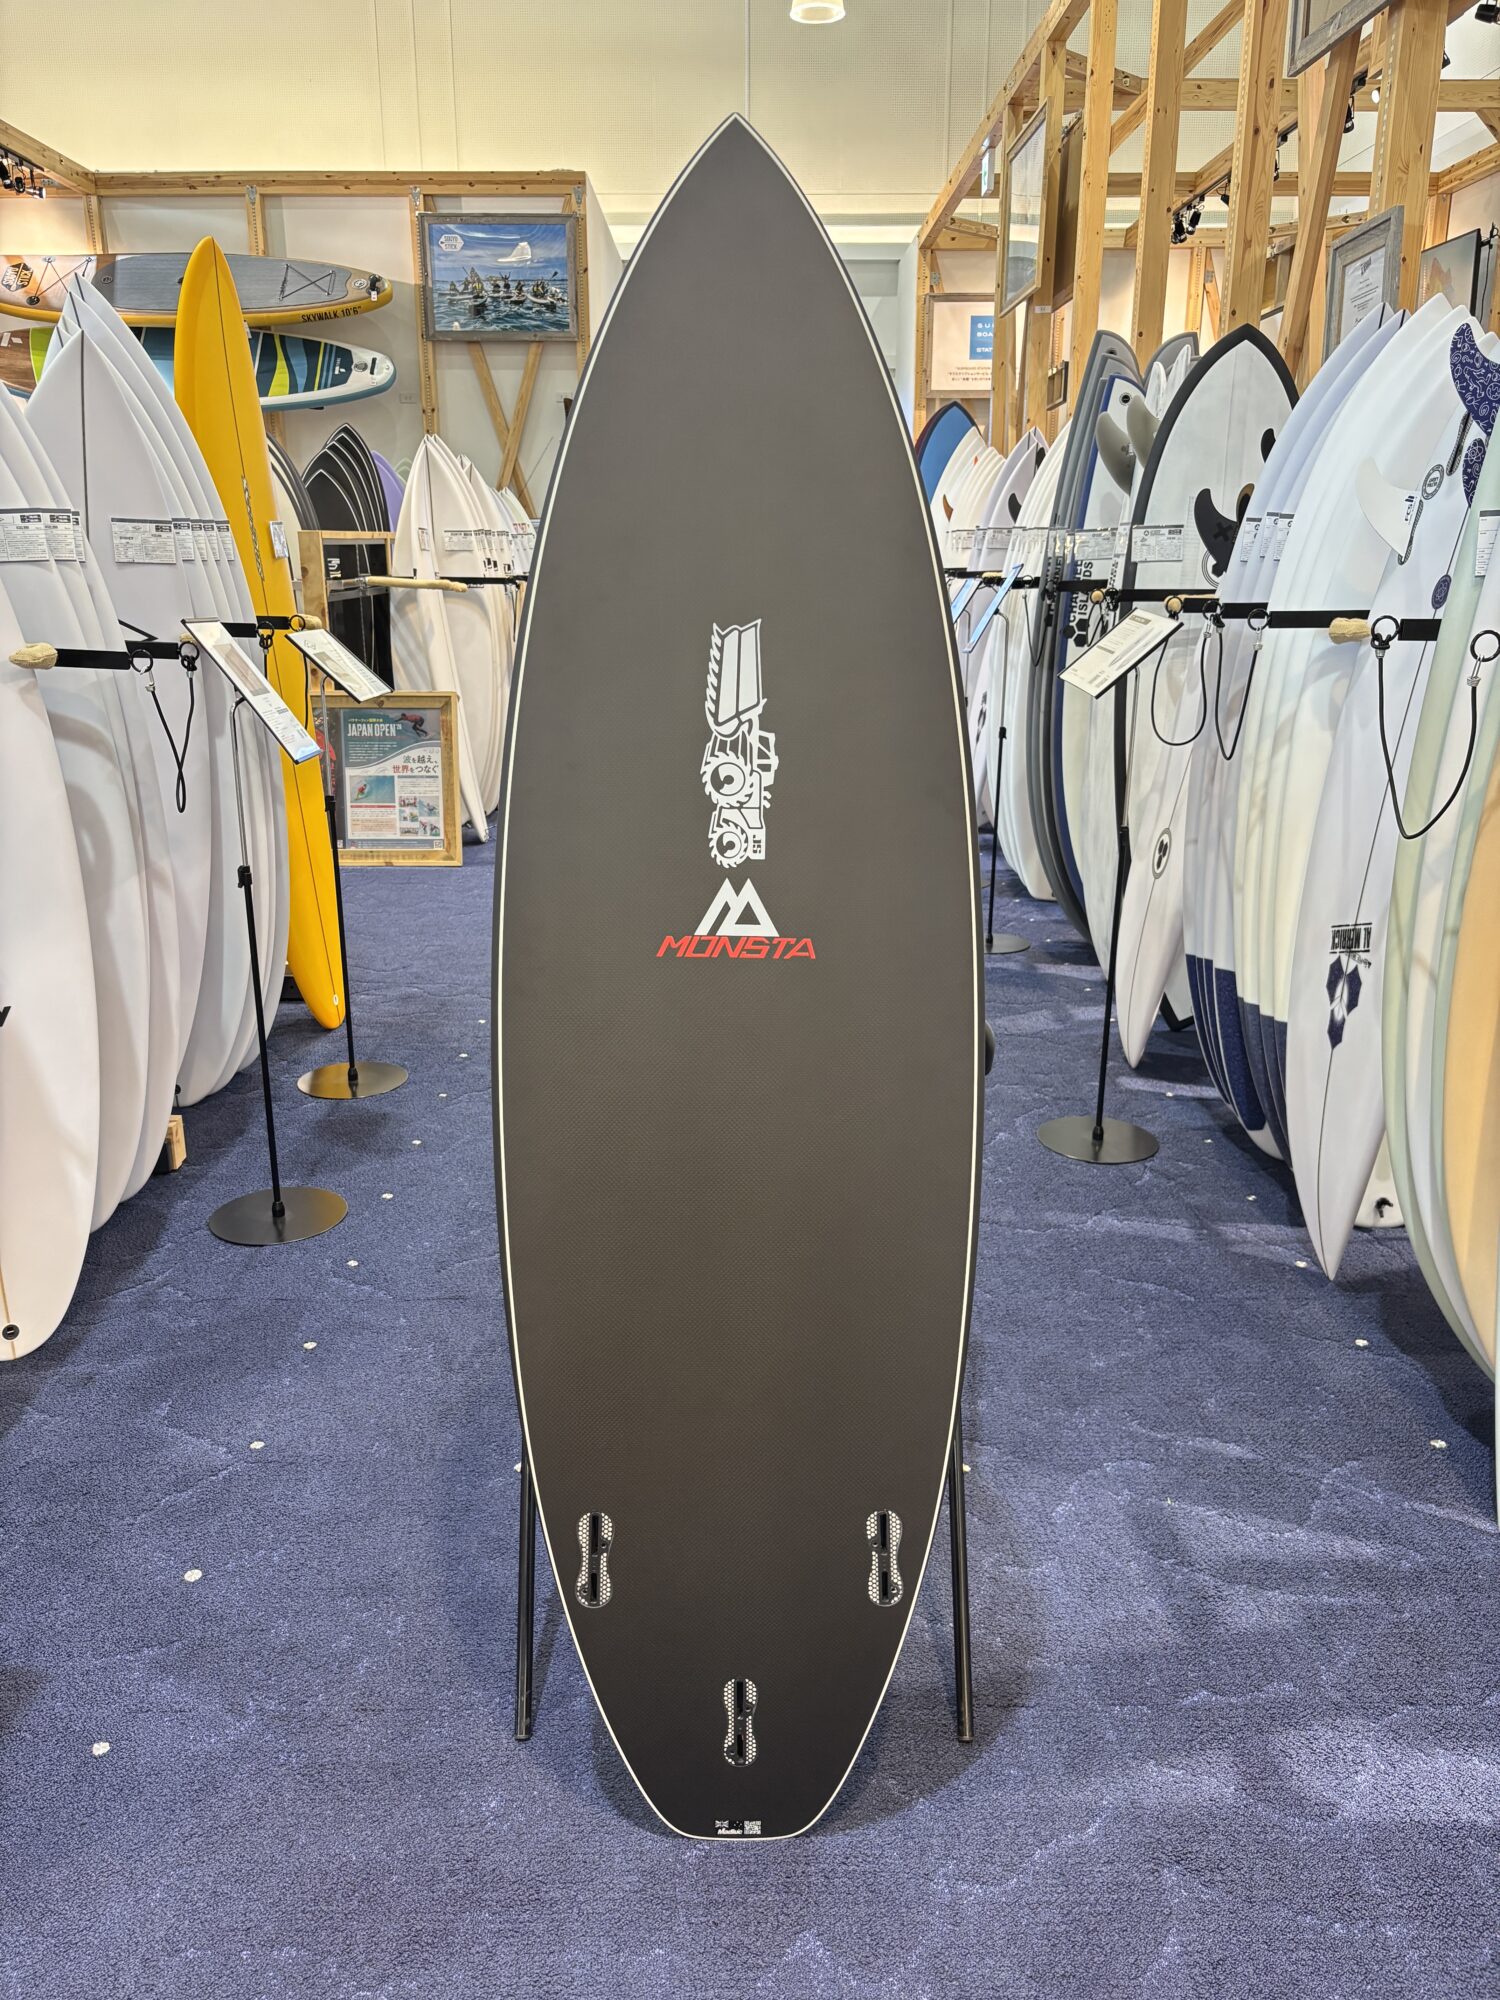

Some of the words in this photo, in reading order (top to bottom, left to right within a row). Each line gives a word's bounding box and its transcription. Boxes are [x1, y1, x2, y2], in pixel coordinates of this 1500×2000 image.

[301, 310, 340, 323] SKYWALK
[347, 723, 373, 737] JAPAN
[374, 723, 396, 737] OPEN
[403, 755, 438, 764] 波を越え、
[392, 764, 439, 774] 世界をつなぐ
[656, 935, 816, 960] MONSTA
